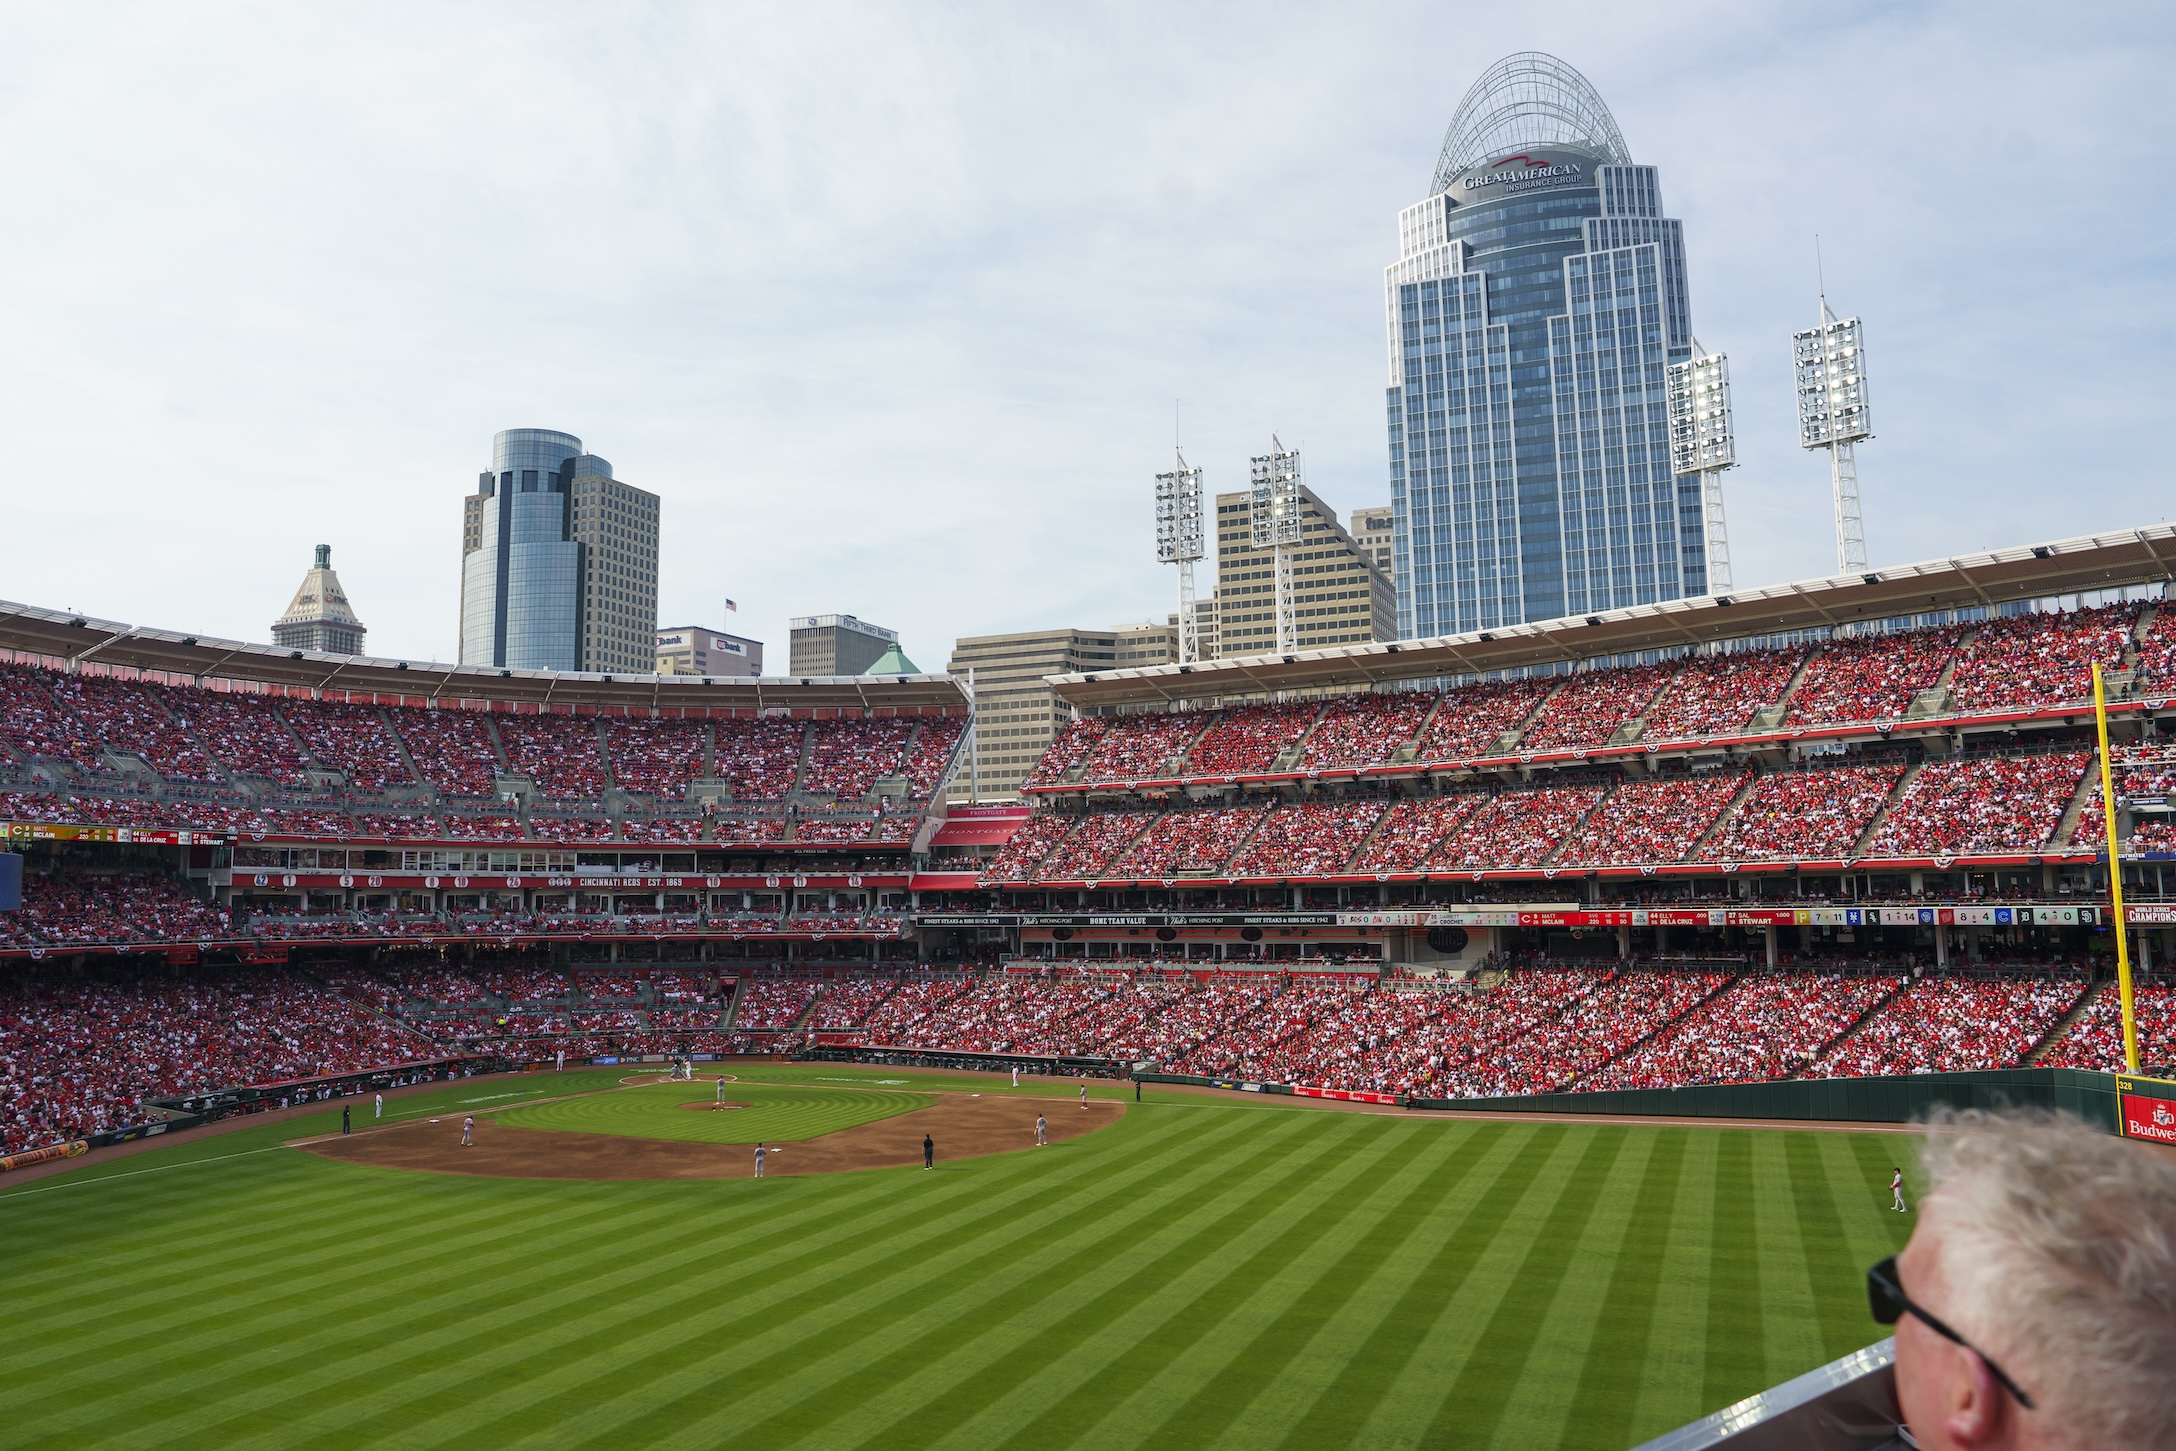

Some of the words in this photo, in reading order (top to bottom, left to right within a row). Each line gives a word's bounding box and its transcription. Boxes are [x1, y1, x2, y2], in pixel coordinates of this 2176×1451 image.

[1462, 170, 1510, 190] GREAT
[1505, 163, 1582, 184] AMERICAN
[1506, 179, 1552, 193] INSURANCE
[1554, 175, 1582, 185] GROUP
[333, 596, 348, 605] PNC
[843, 618, 859, 629] FIFTH
[859, 622, 877, 635] THIRD
[877, 628, 892, 640] BANK
[256, 875, 266, 885] 42
[370, 877, 380, 886] 20
[509, 877, 519, 887] 24
[579, 878, 621, 886] CINCINNATI
[623, 878, 641, 886] REDS
[647, 878, 664, 886] EST.
[666, 878, 682, 886] 1869
[709, 877, 718, 887] 10
[768, 877, 777, 886] 13
[796, 877, 804, 886] 11
[851, 877, 860, 886] 14
[1800, 913, 1807, 923] P
[1816, 913, 1821, 921] 7
[1833, 913, 1842, 921] 11
[1904, 913, 1915, 921] 14
[1960, 913, 1967, 921] 8
[1983, 912, 1989, 921] 4
[1998, 911, 2008, 922] C
[2040, 912, 2047, 920] 4
[2064, 912, 2072, 921] 0
[2081, 910, 2092, 923] SD
[2129, 910, 2176, 922] CHAMPIONS
[2119, 1081, 2133, 1090] 328
[12, 1151, 44, 1166] GORILLA
[44, 1147, 62, 1158] TAPE
